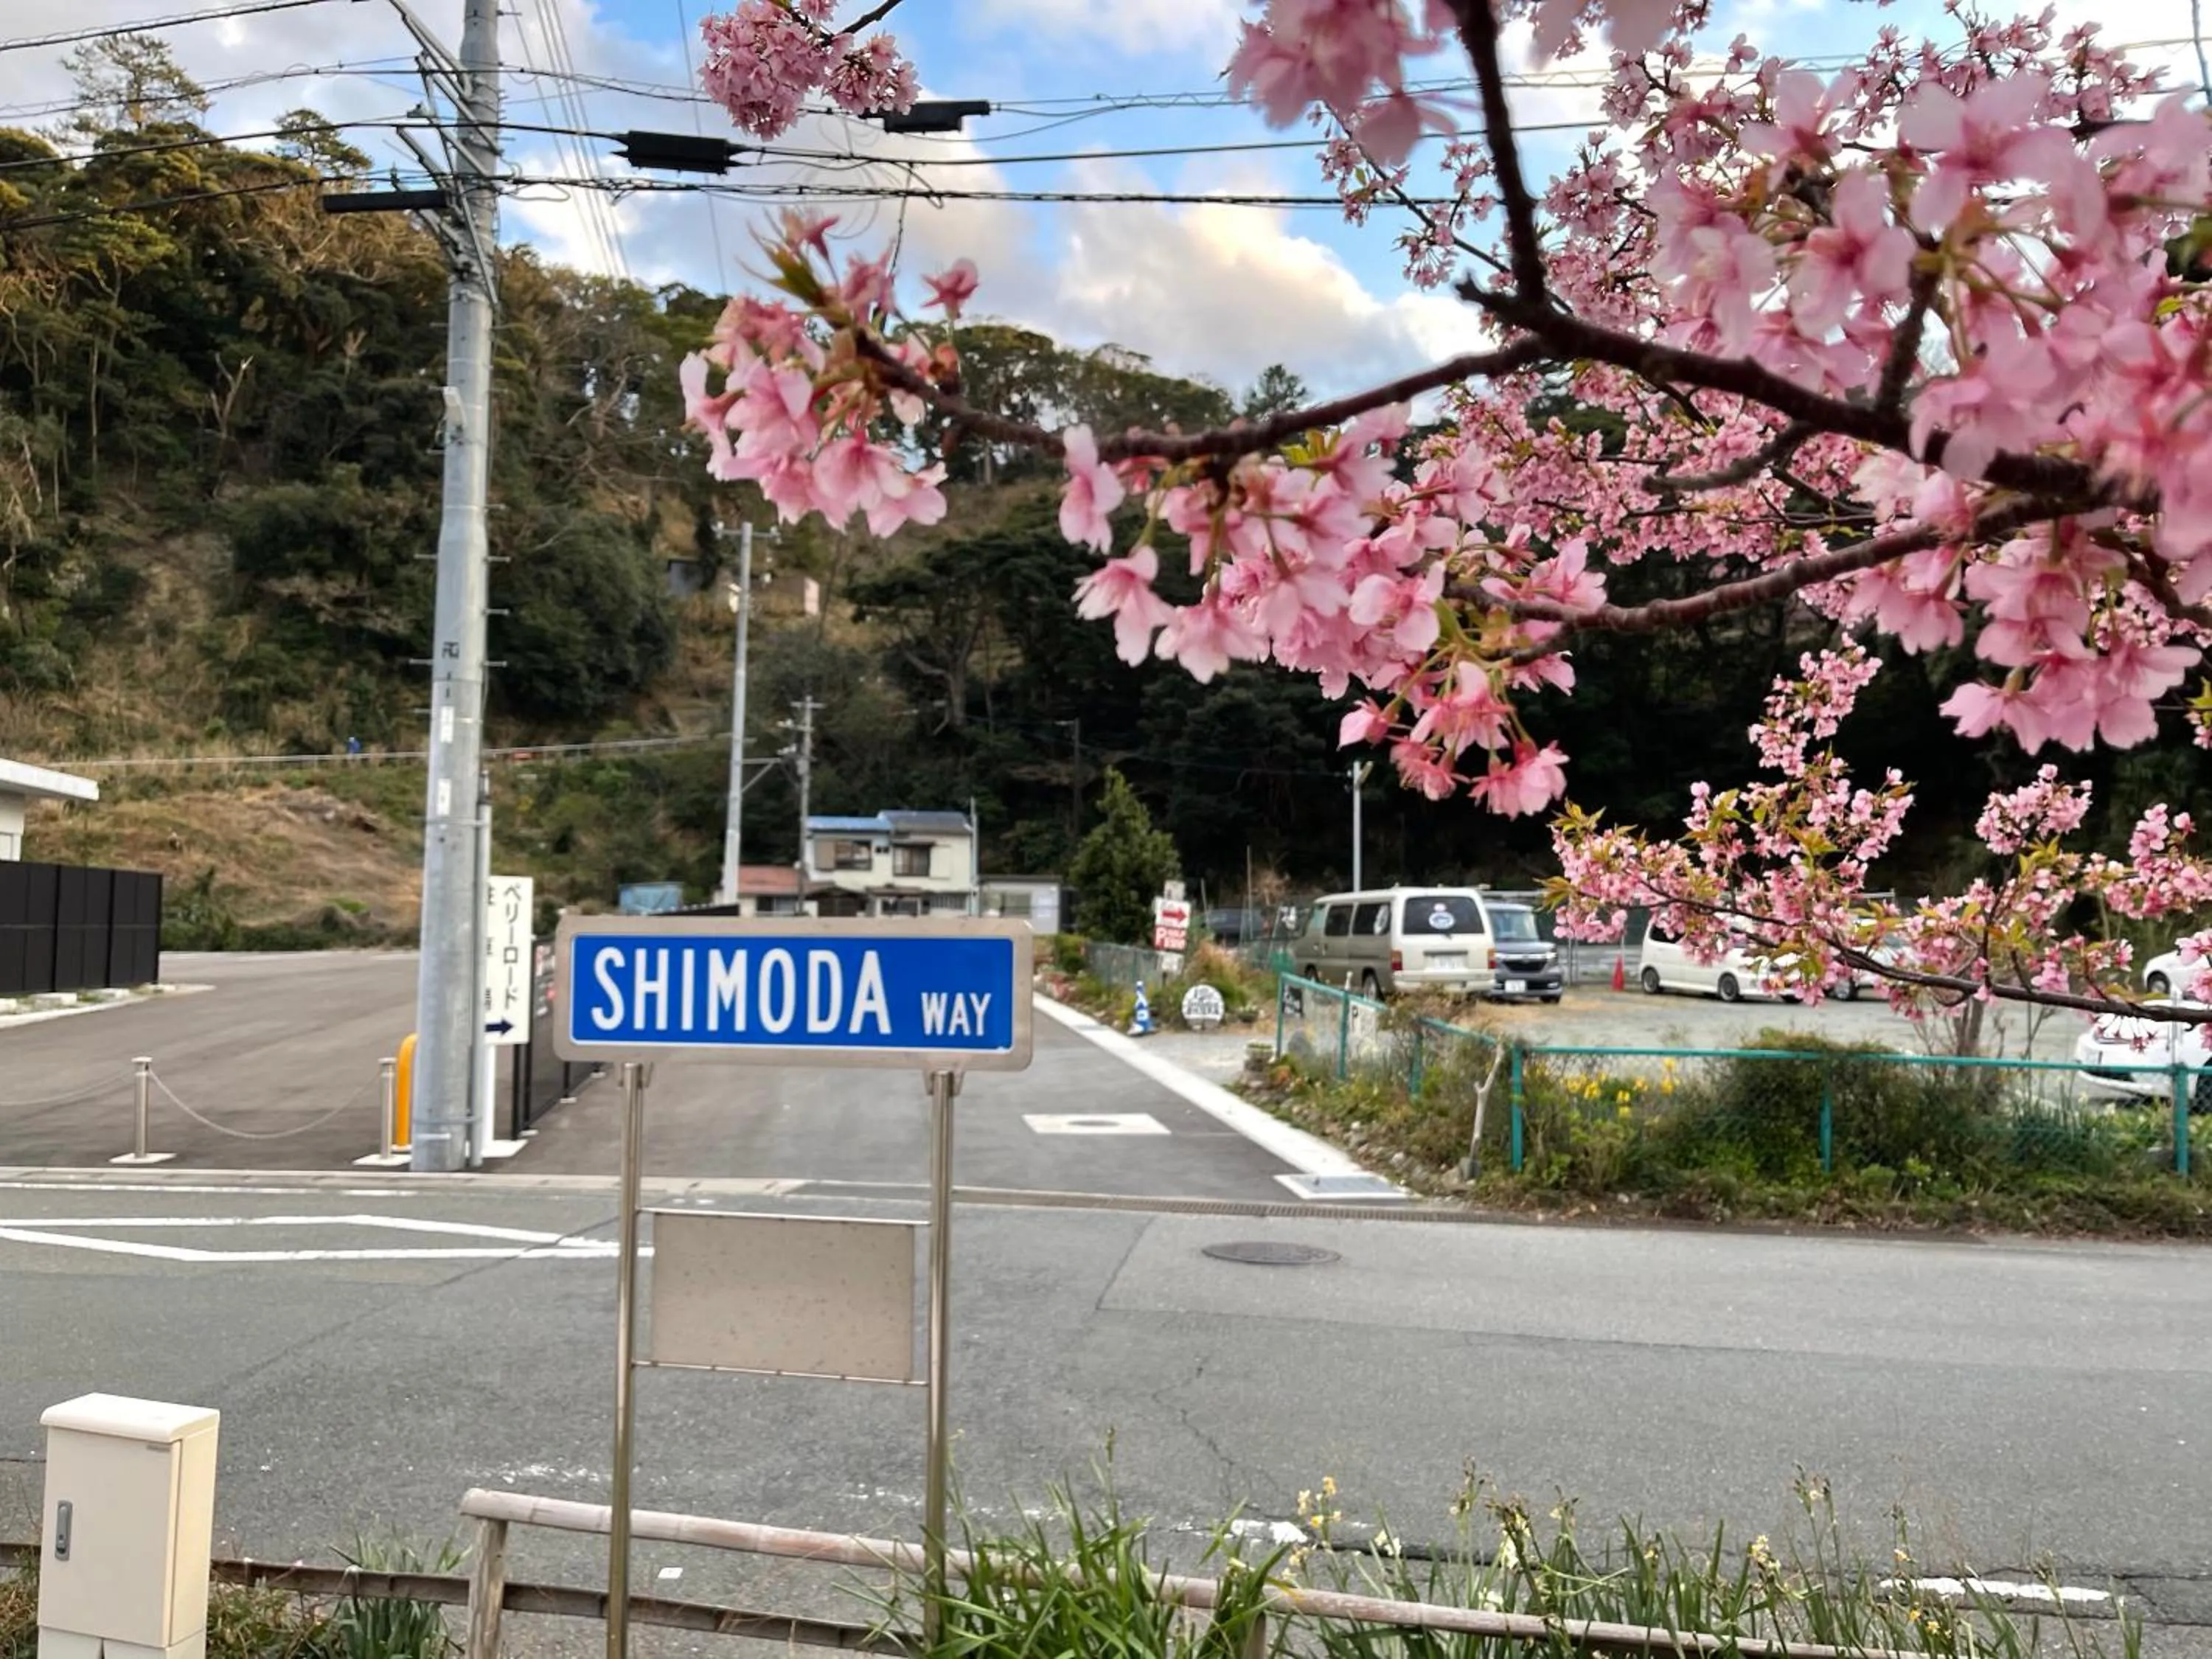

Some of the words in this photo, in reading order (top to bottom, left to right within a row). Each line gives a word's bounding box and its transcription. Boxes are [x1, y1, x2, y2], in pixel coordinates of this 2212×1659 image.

[503, 883, 521, 1010] ペリーロード
[591, 947, 891, 1034] SHIMODA
[921, 992, 991, 1036] WAY
